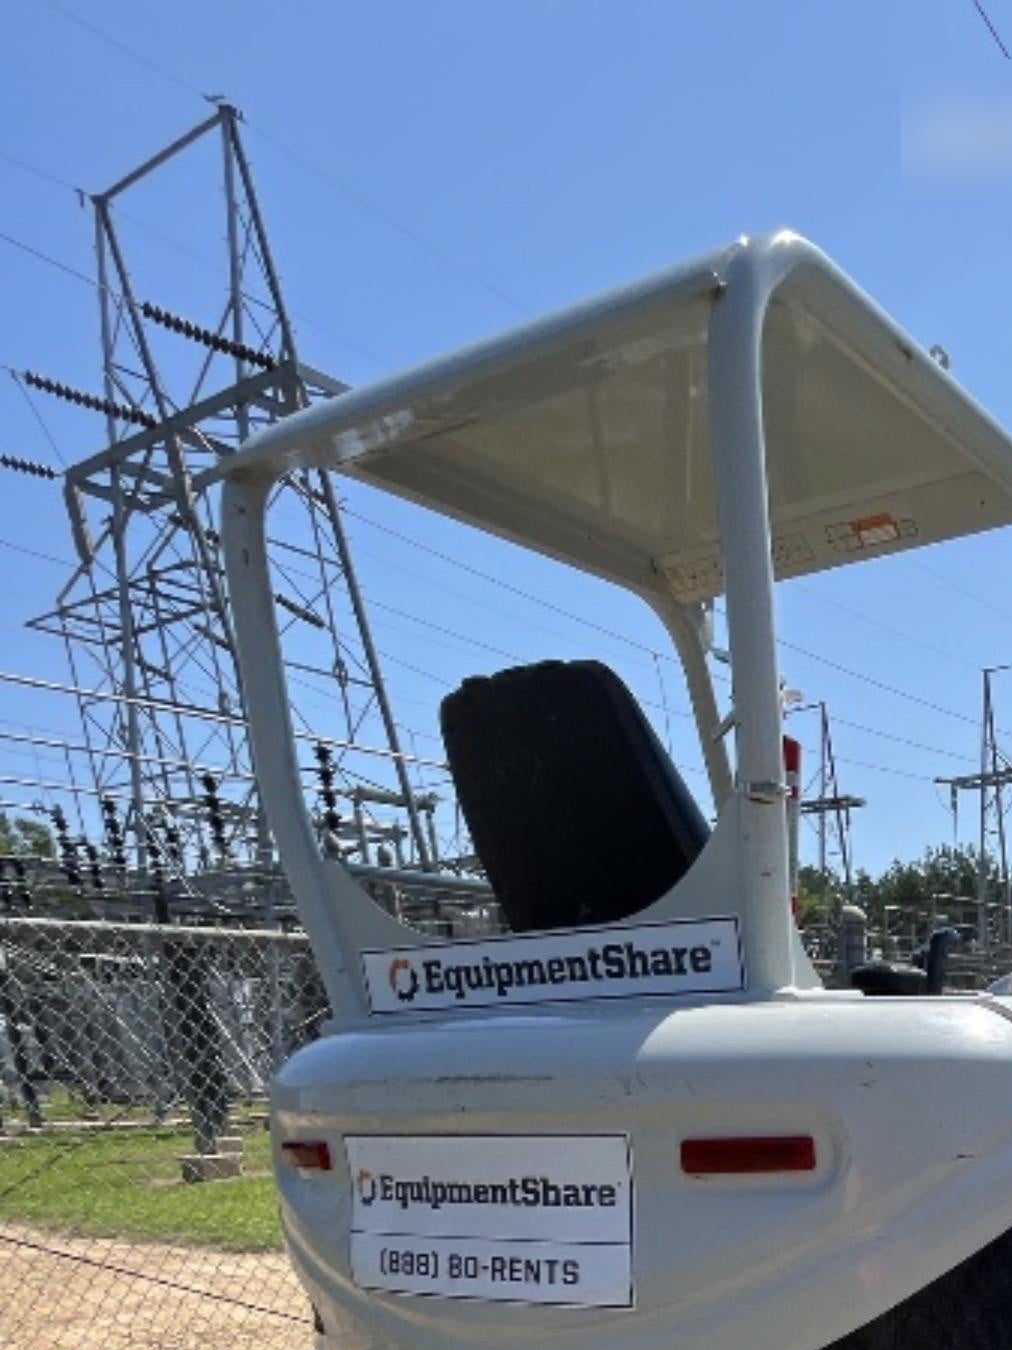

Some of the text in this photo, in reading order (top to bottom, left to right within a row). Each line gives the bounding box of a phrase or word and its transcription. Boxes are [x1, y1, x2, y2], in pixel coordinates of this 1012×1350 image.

[422, 942, 712, 998] EquipmentShare
[380, 1174, 616, 1209] EquipmentShare
[380, 1248, 438, 1279] (888)
